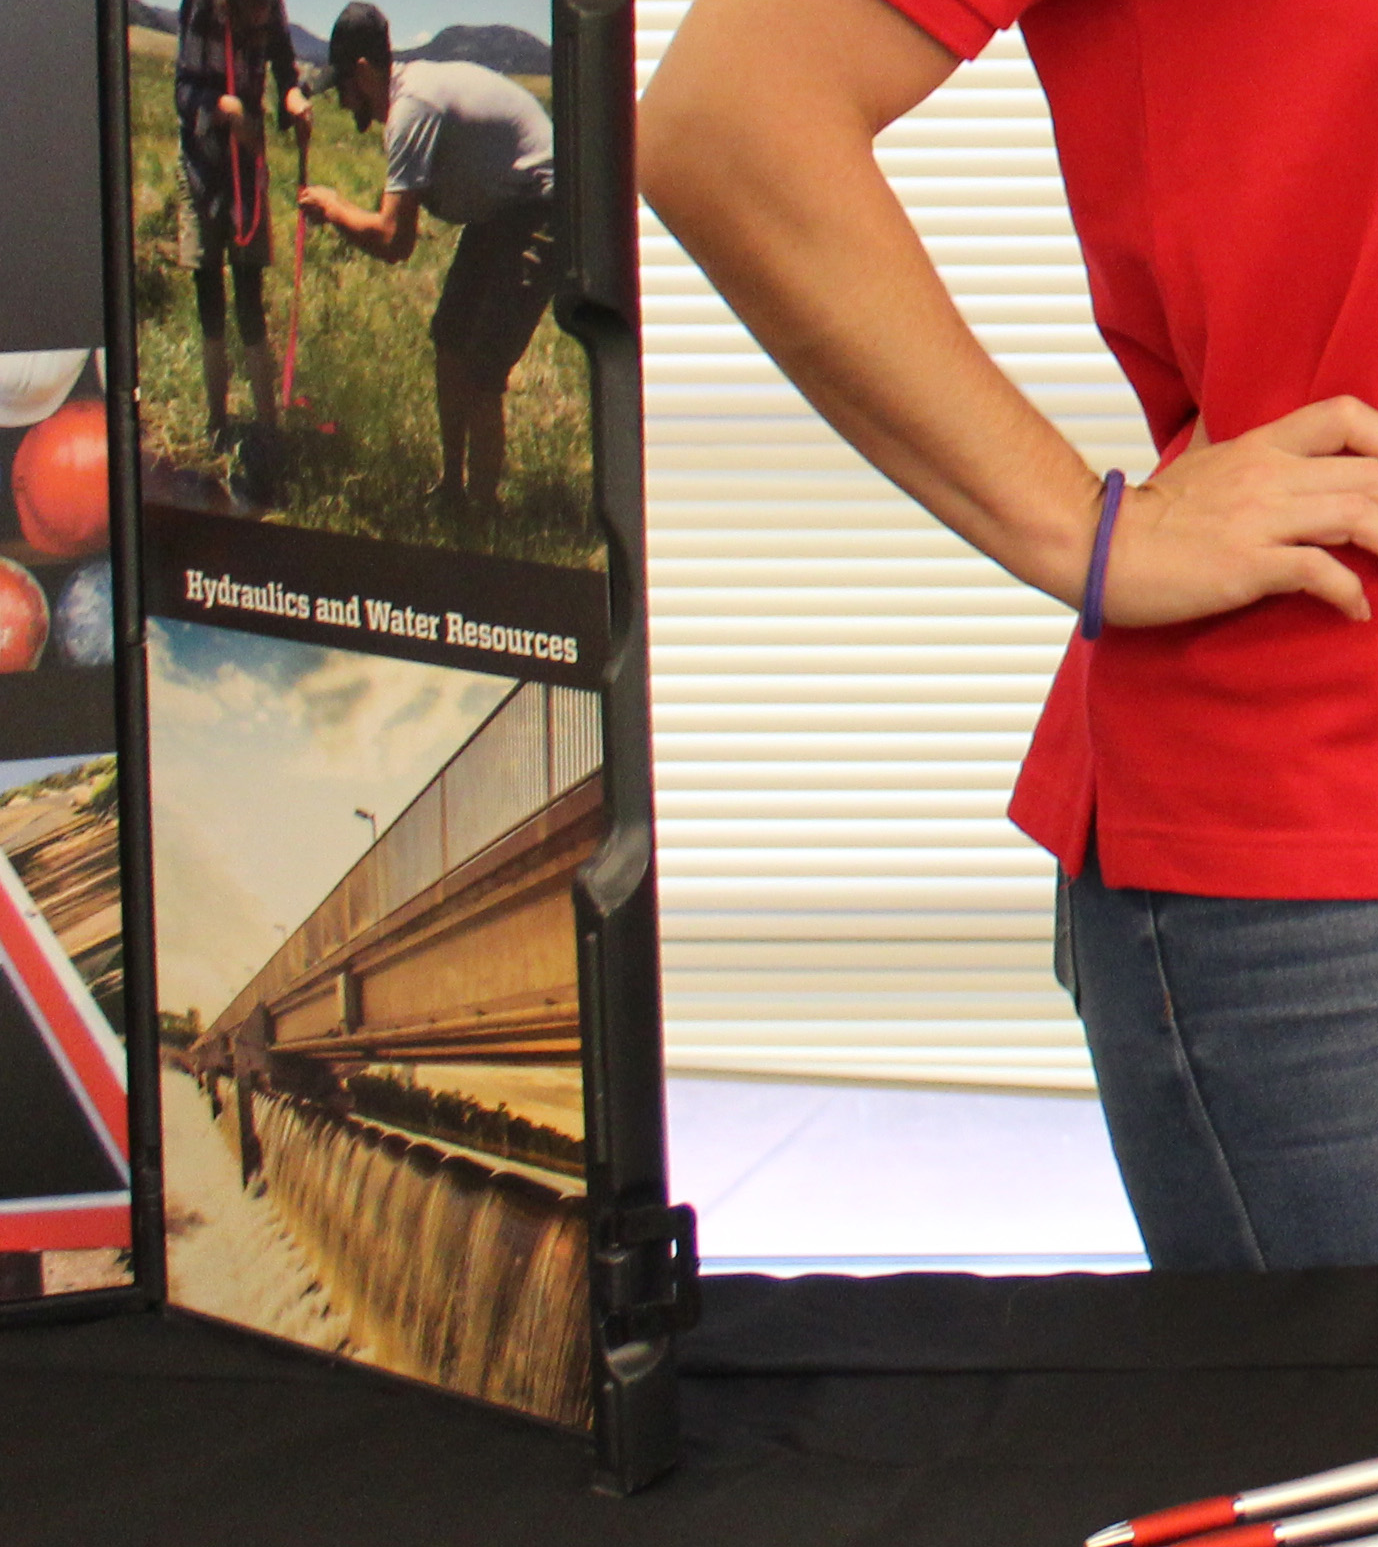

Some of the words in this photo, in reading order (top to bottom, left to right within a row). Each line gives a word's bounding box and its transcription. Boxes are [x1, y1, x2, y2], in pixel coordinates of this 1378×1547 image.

[185, 569, 311, 620] Hydraulics
[315, 595, 361, 629] and
[365, 599, 441, 641] Water
[445, 612, 579, 665] Resources
